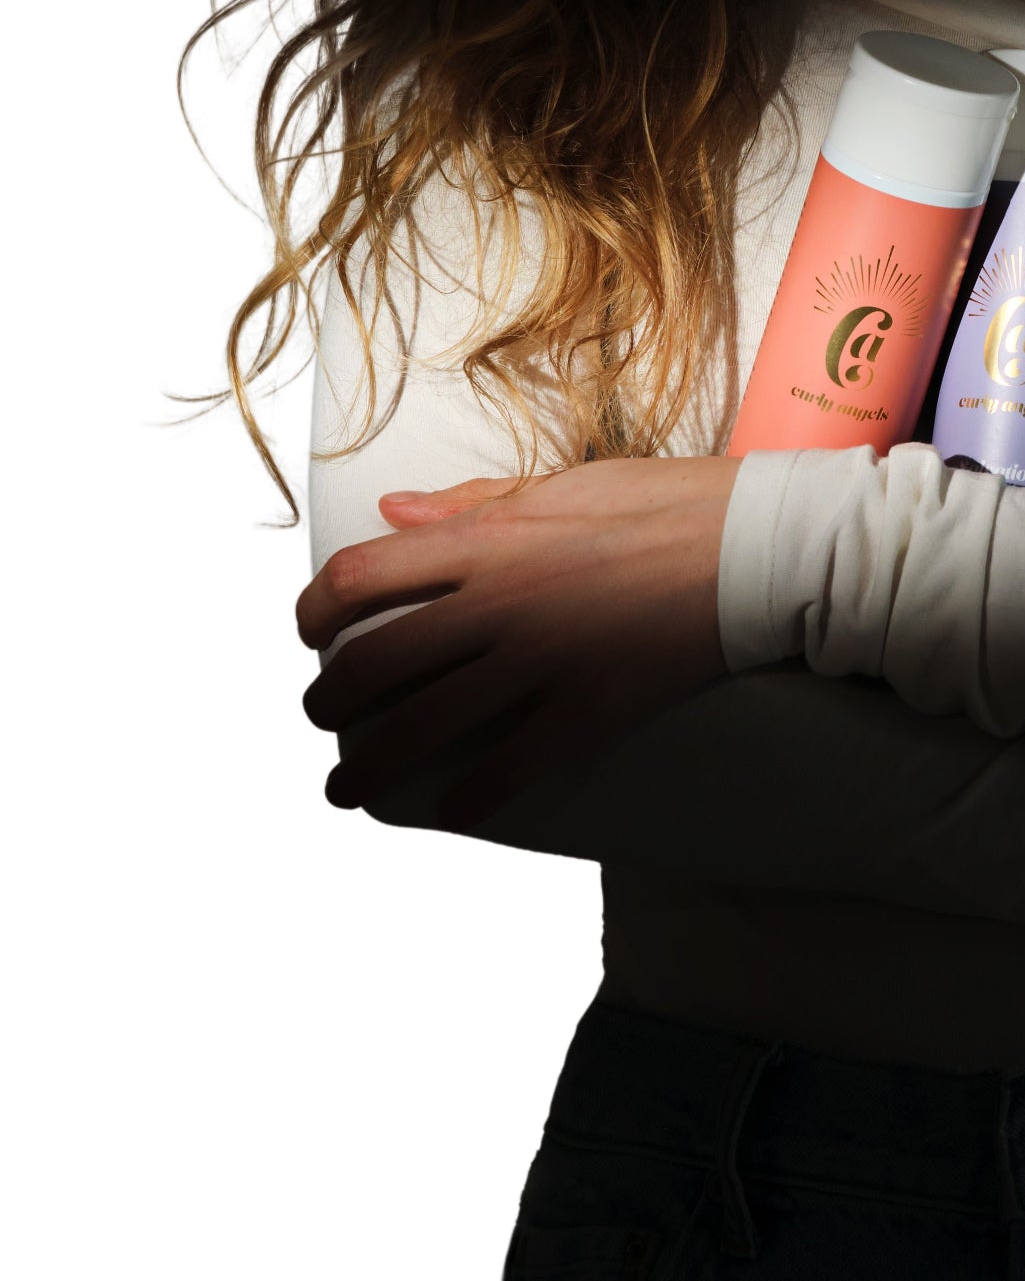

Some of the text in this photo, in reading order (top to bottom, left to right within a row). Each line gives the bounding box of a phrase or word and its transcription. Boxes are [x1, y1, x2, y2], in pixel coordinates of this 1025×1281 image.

[790, 385, 890, 422] curly angels
[958, 393, 999, 415] curly
